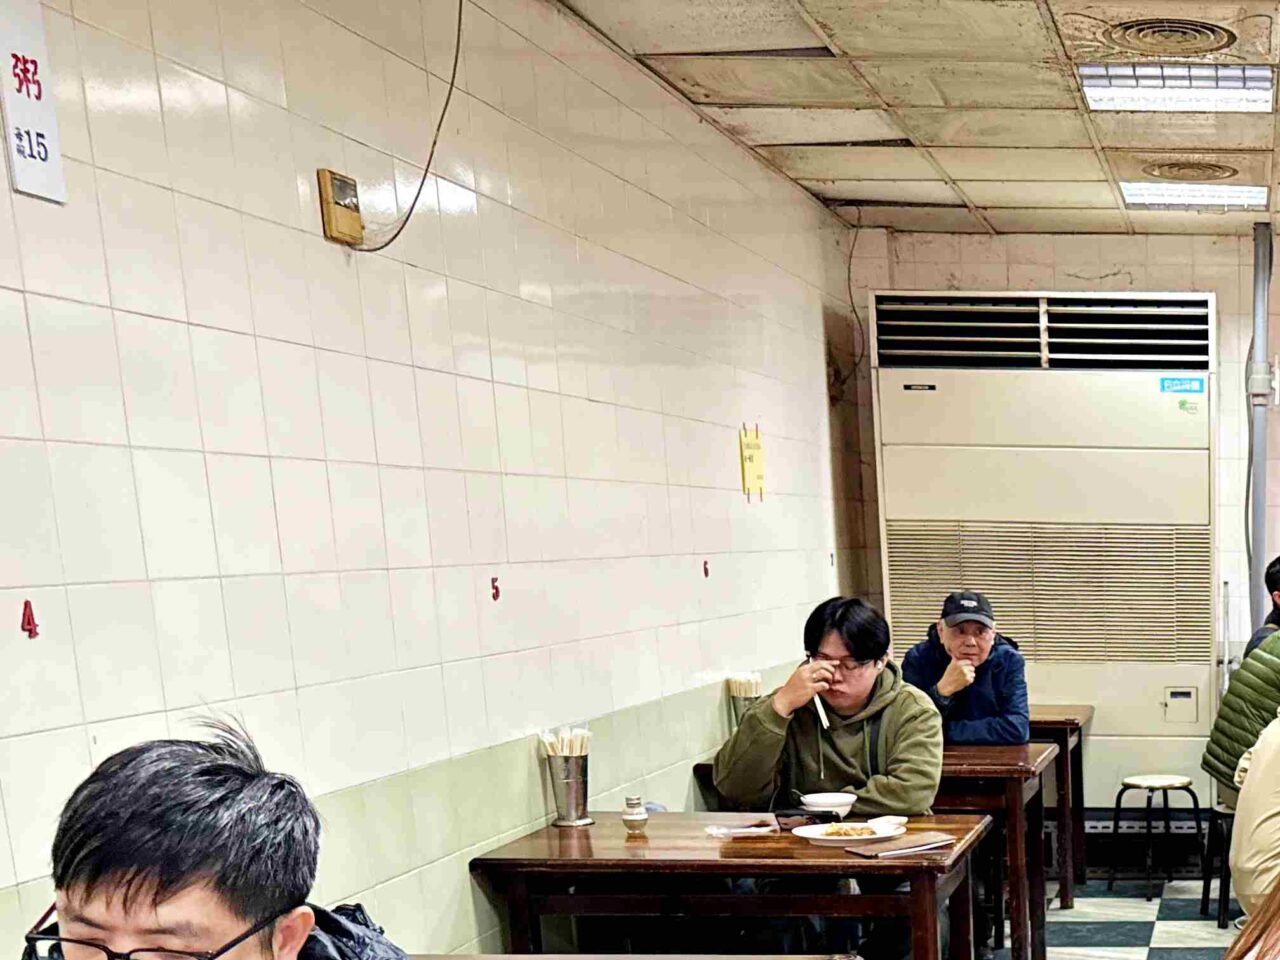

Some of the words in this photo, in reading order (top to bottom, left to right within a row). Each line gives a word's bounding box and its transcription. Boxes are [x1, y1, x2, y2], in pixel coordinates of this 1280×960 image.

[11, 53, 42, 101] 粥
[25, 129, 48, 162] 15
[491, 577, 500, 601] 5
[21, 600, 39, 639] 4
